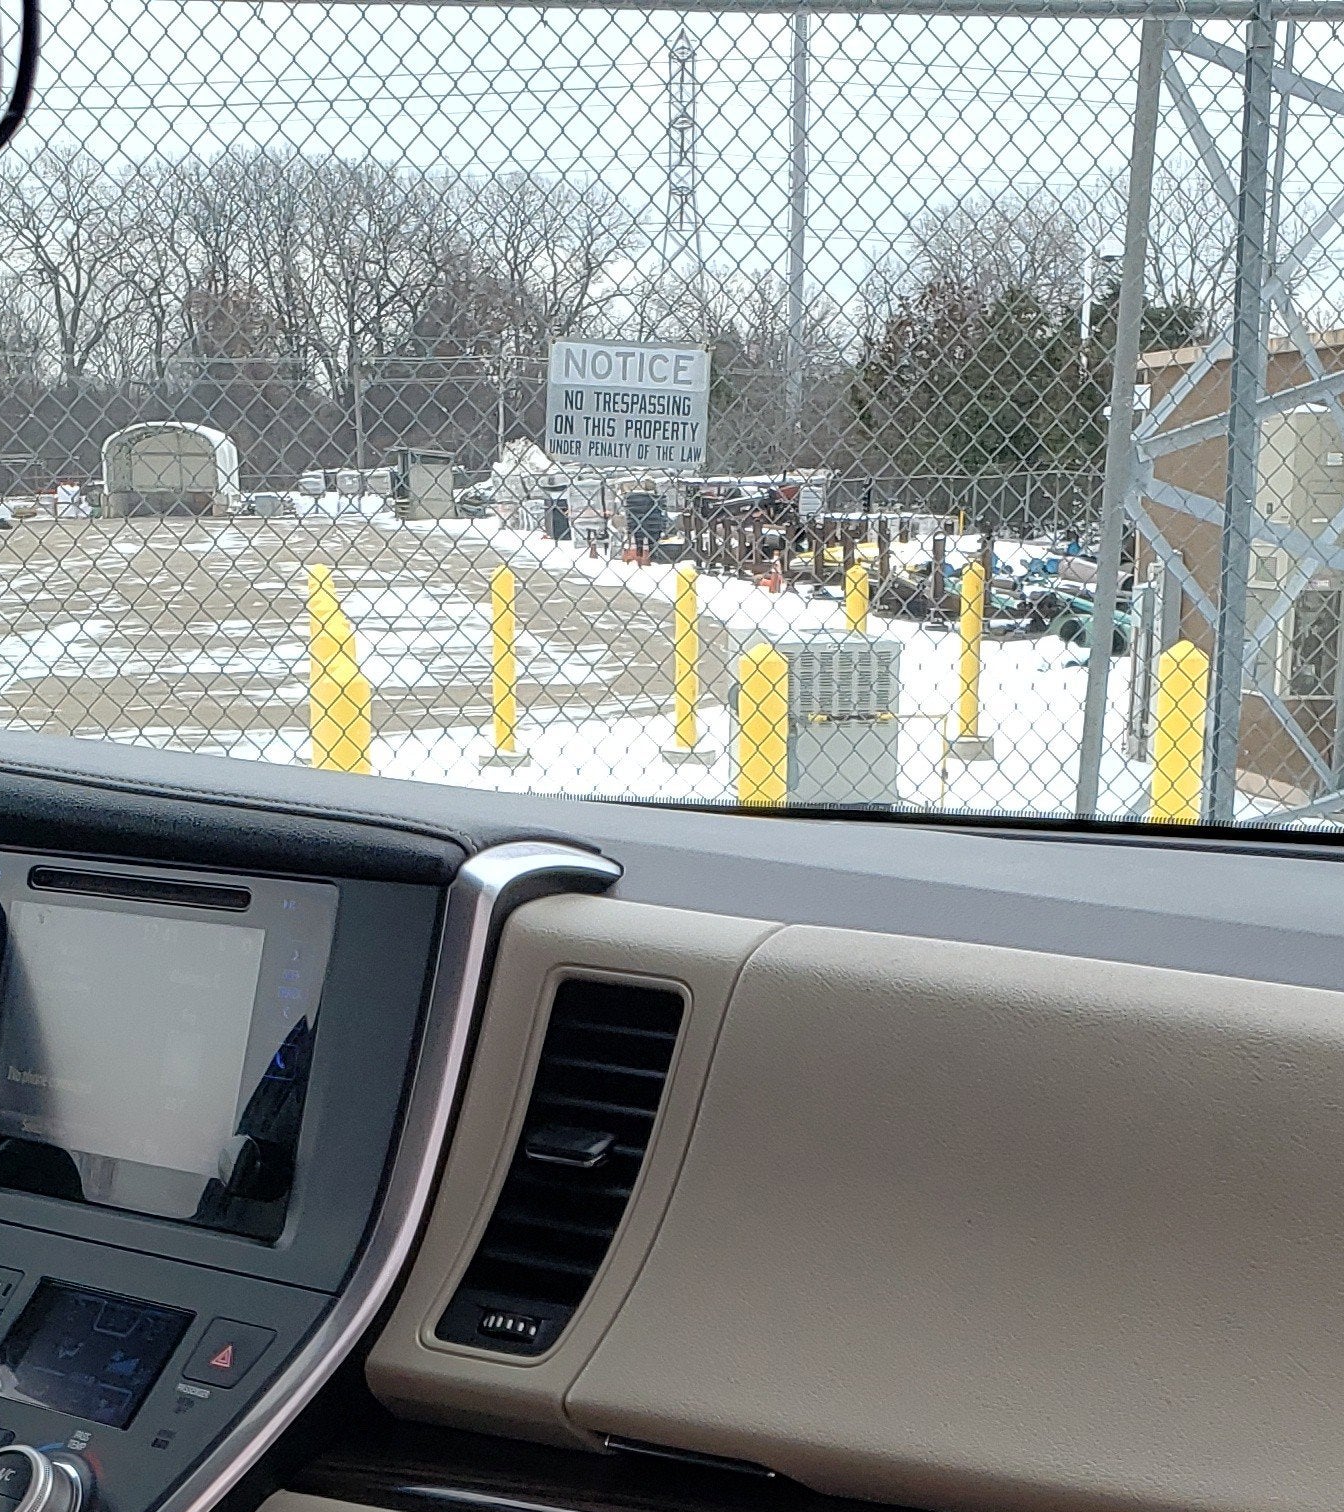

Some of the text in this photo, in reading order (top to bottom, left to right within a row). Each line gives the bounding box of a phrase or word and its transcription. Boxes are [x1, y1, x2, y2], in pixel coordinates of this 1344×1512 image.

[564, 348, 694, 385] NOTICE
[564, 389, 691, 416] NO TRESPASSING
[554, 414, 700, 442] ON THIS PROPERTY
[549, 439, 702, 463] UNDER PENALTY OF THE LAW
